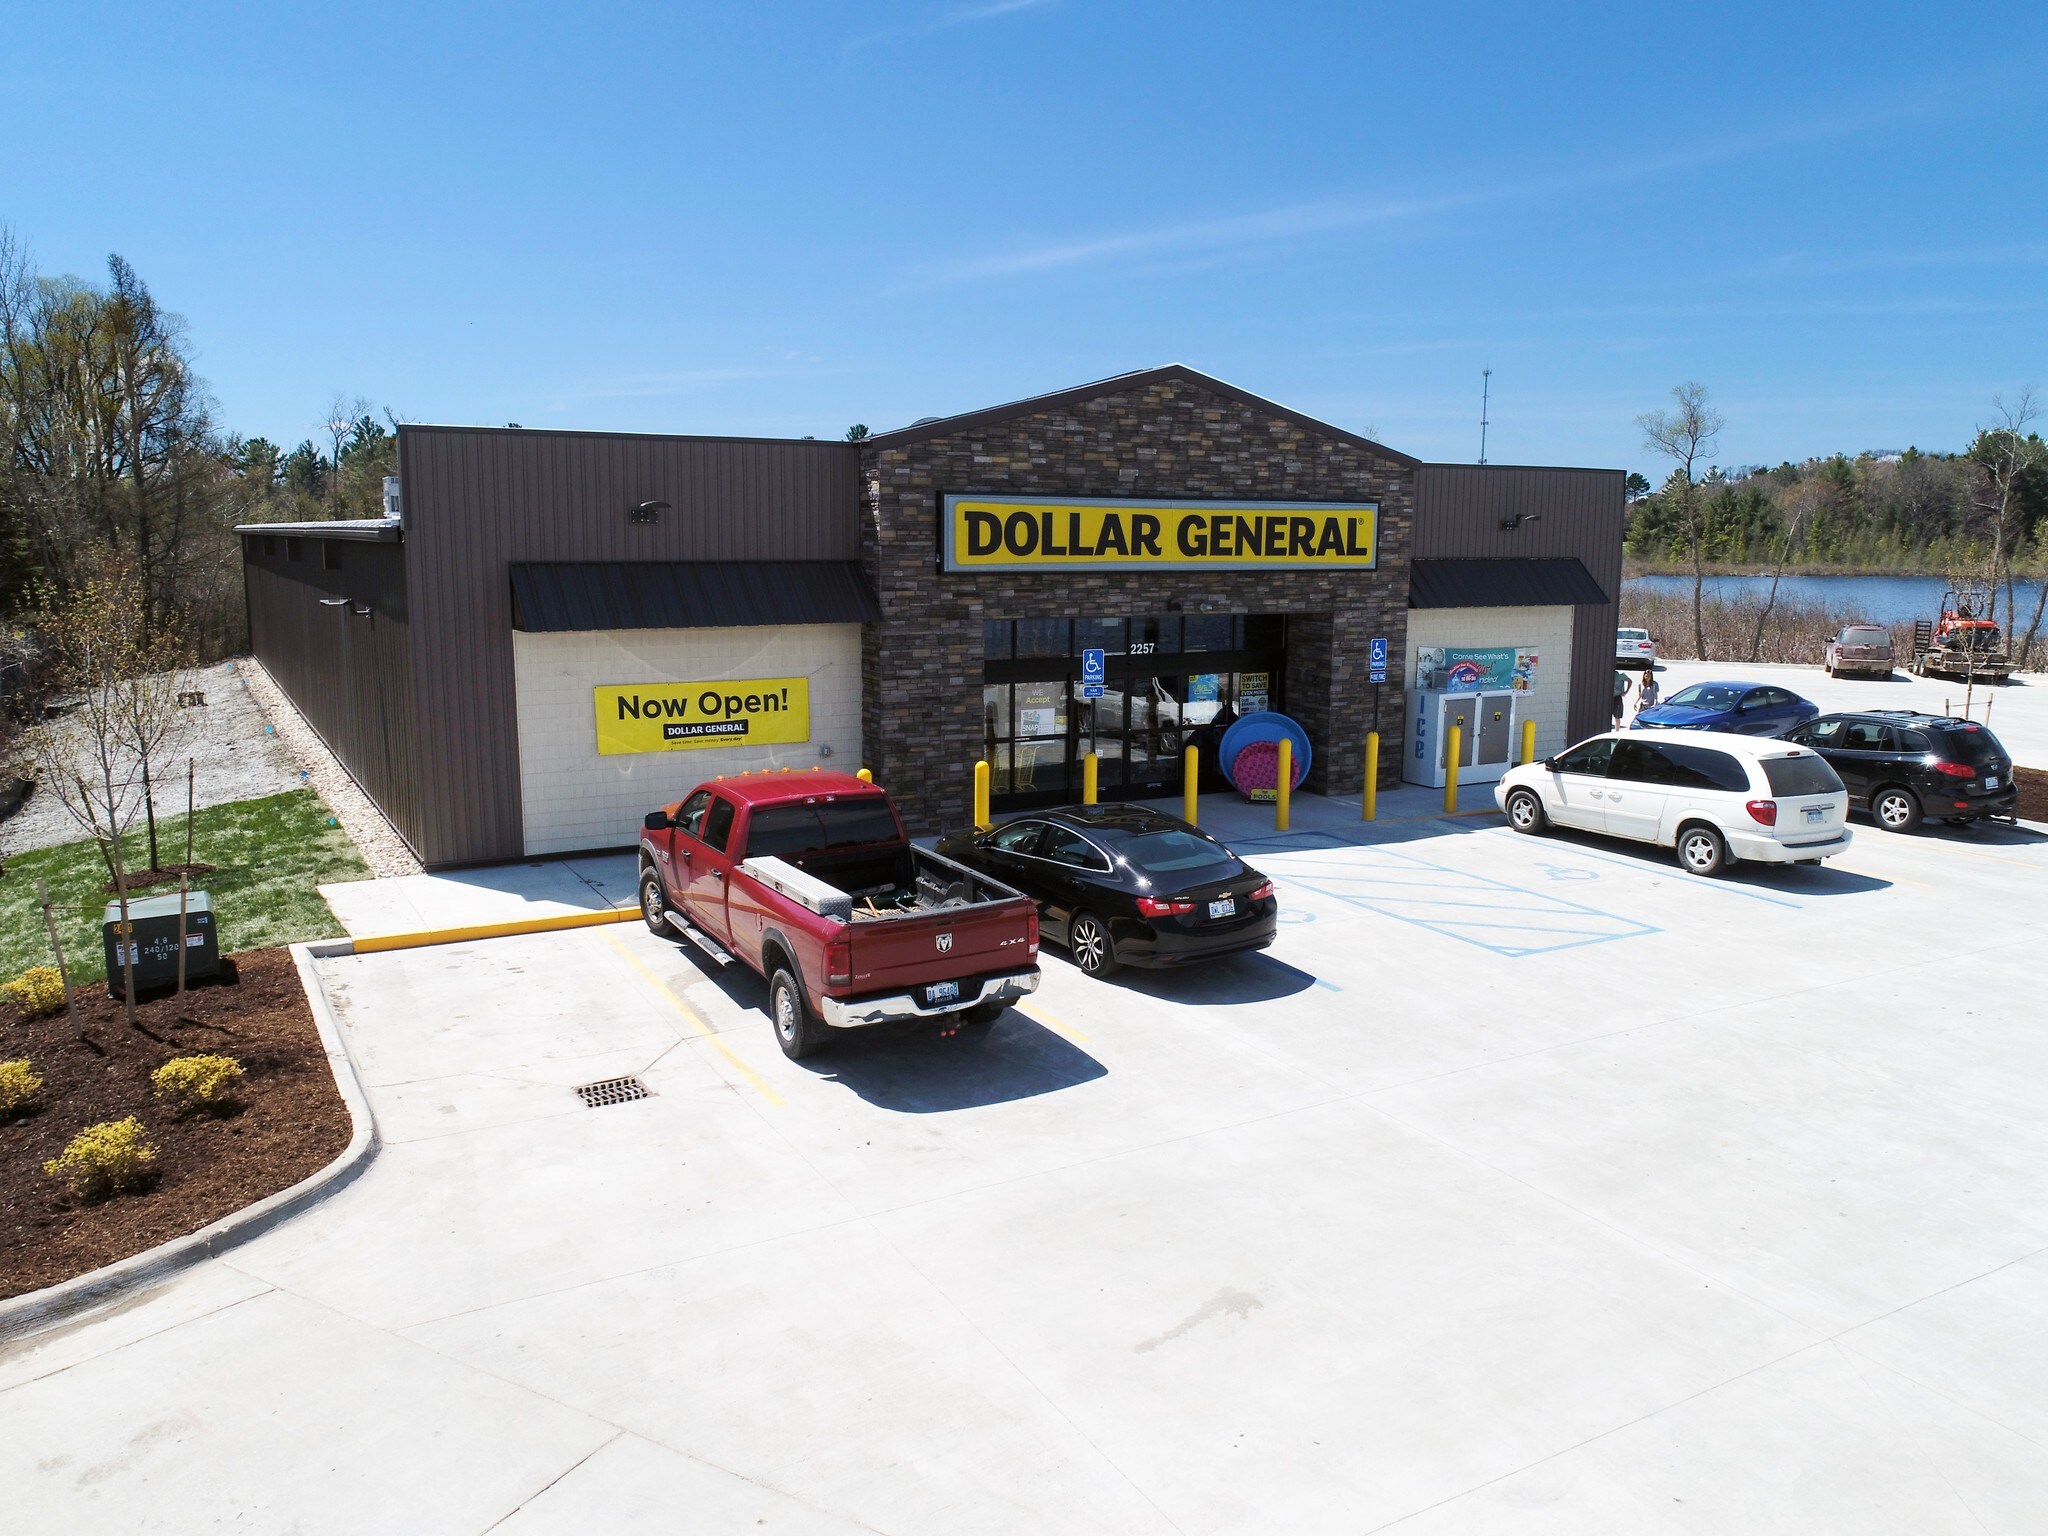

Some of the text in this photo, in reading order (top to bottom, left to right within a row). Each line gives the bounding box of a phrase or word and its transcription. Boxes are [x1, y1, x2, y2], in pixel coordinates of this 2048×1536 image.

[964, 511, 1367, 557] DOLLAR GENERAL
[1130, 643, 1155, 655] 2257
[1241, 674, 1268, 682] SWITCH
[617, 688, 788, 720] Now Open!
[1026, 696, 1051, 704] Accept
[667, 723, 745, 736] DOLLAR GENERAL
[1023, 723, 1039, 732] SNAP
[144, 943, 180, 955] 240/120
[157, 952, 168, 961] 50
